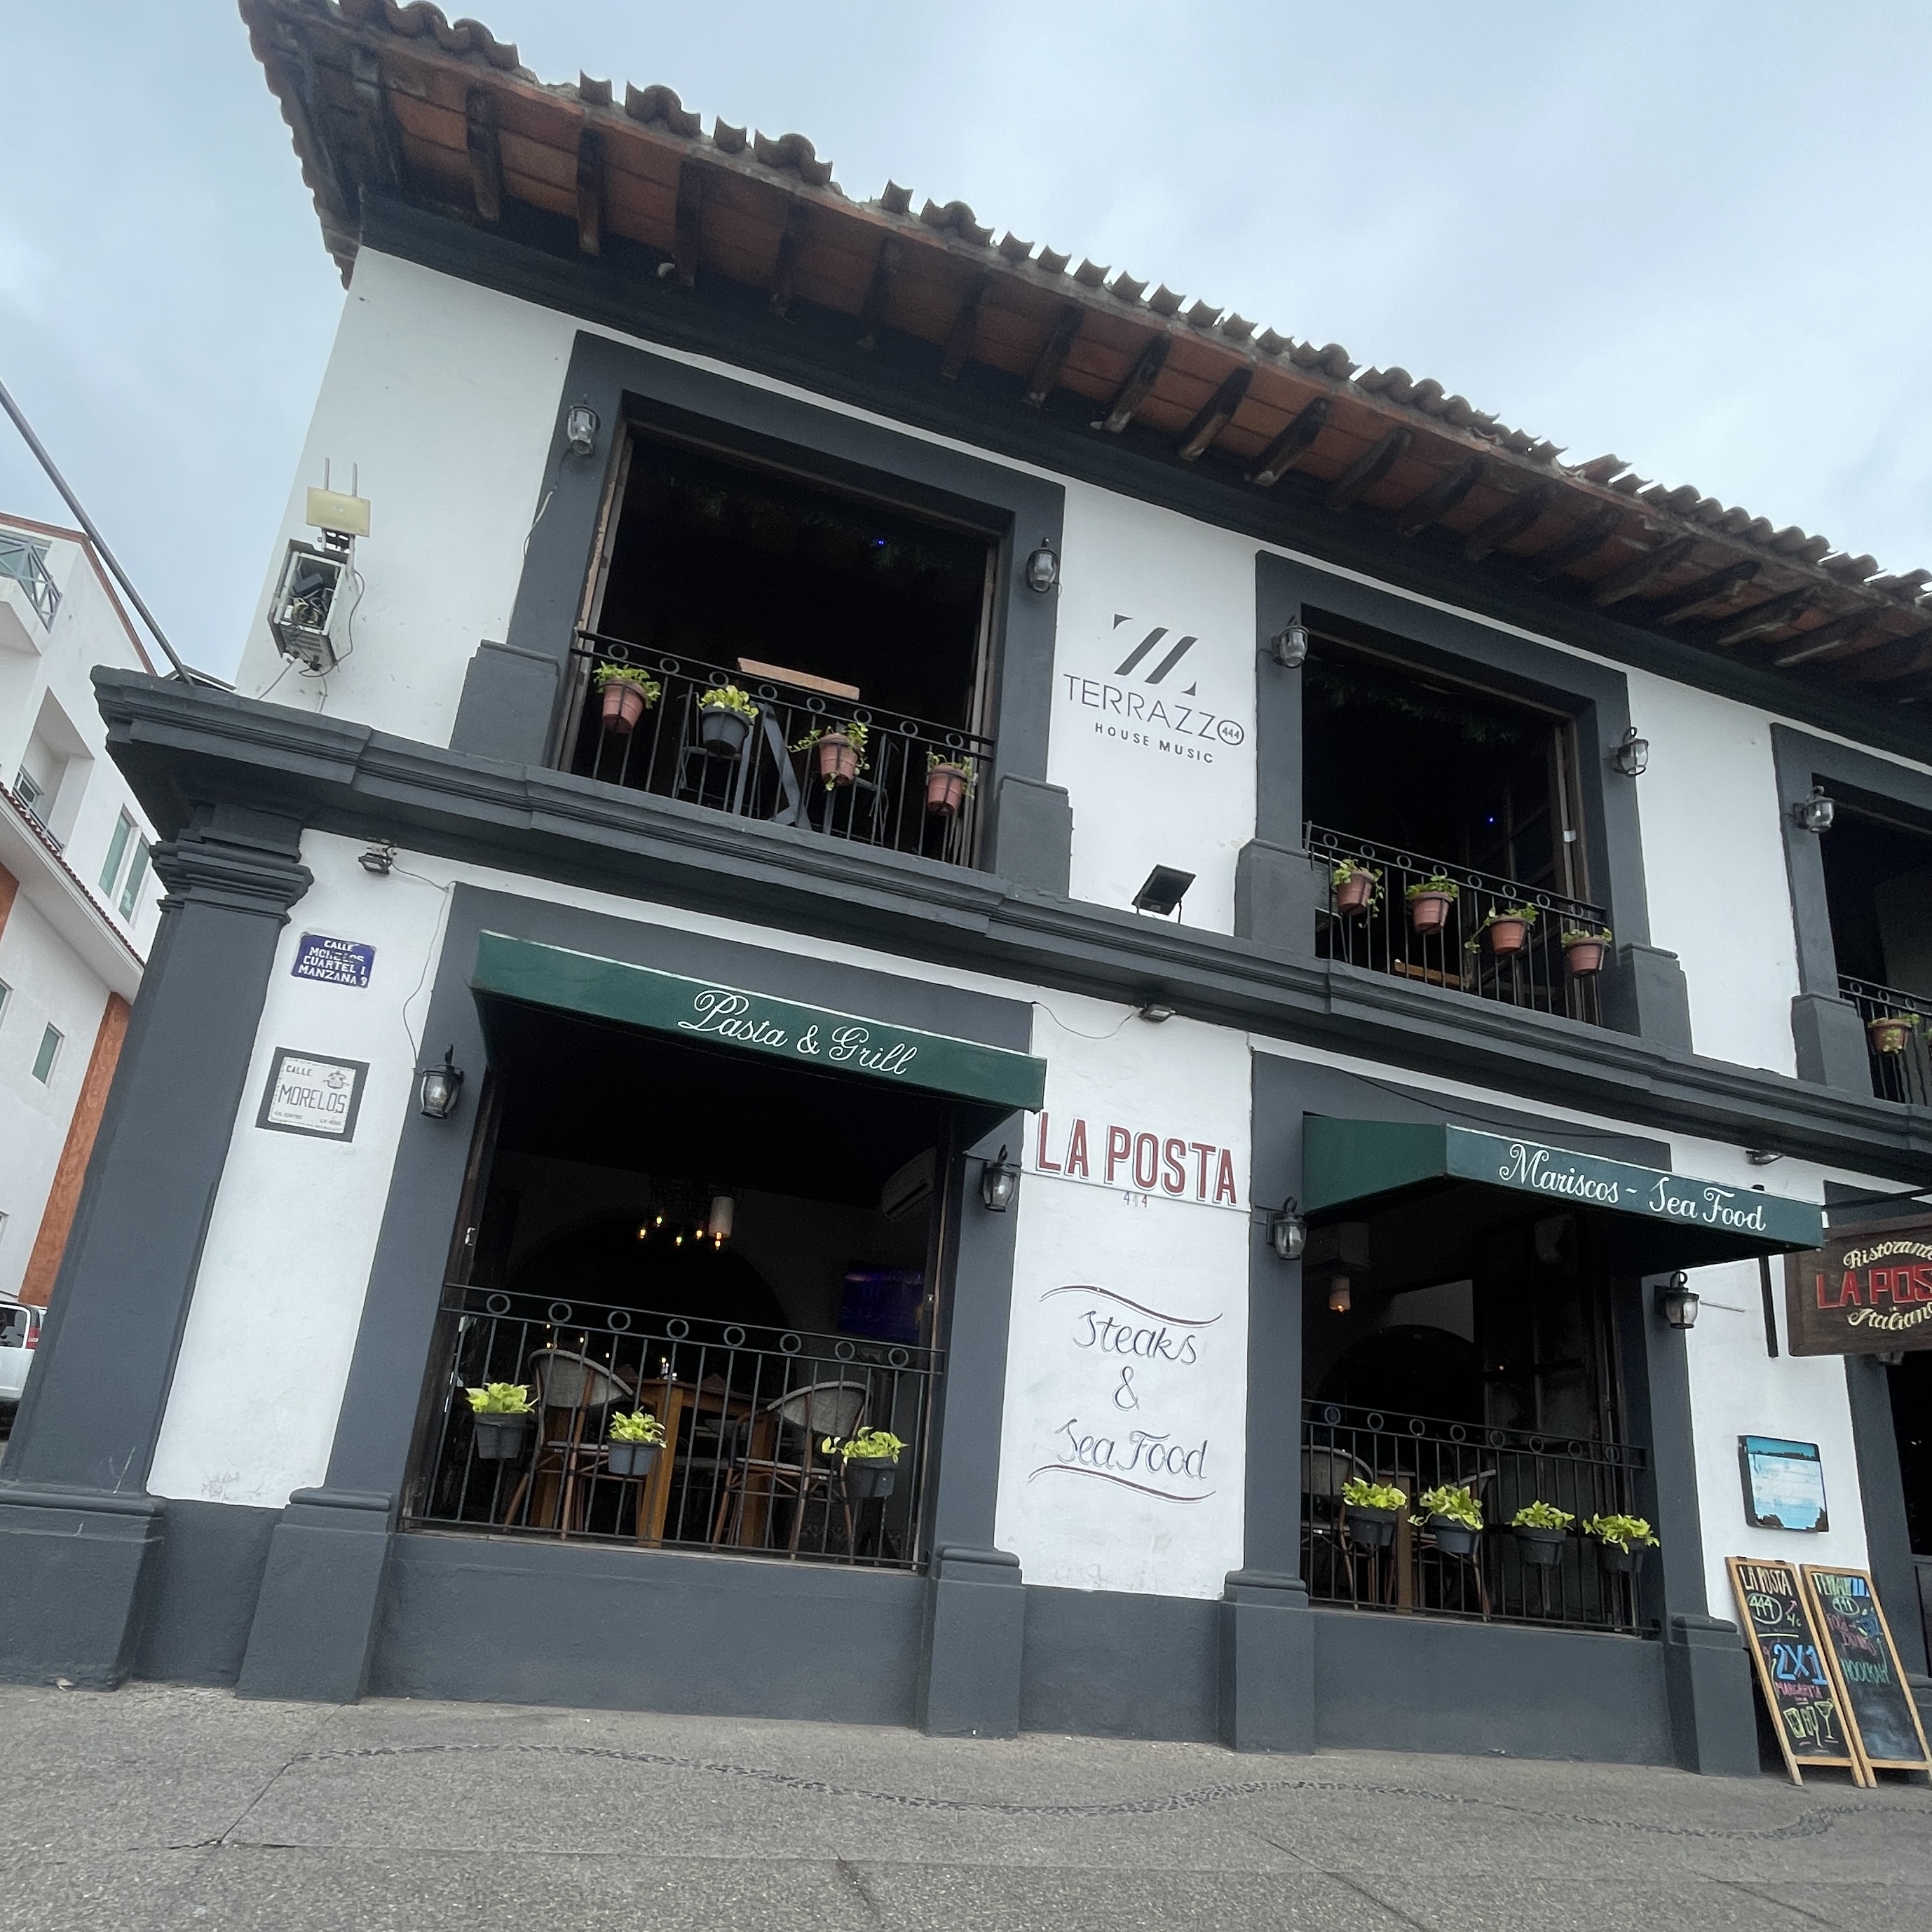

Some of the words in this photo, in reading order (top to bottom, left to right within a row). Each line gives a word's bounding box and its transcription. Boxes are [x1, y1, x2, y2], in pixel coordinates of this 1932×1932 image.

[1094, 722, 1150, 747] HOUSE
[1159, 740, 1213, 763] MUSIC
[1221, 726, 1240, 740] 444
[303, 955, 356, 974] CUARTEL
[324, 940, 353, 952] CALLE
[298, 965, 357, 985] MANZANA
[677, 990, 788, 1047] Pasta
[796, 1025, 821, 1055] &
[829, 1026, 918, 1075] Grill
[286, 1065, 313, 1077] CALLE
[278, 1084, 347, 1114] MORELOS
[1035, 1111, 1089, 1179] LA
[1104, 1124, 1237, 1206] POSTA
[1499, 1143, 1619, 1203] Mariscos
[1648, 1177, 1698, 1219] Sea
[1703, 1187, 1767, 1232] Food
[1816, 1270, 1862, 1309] LA
[1073, 1310, 1197, 1365] Steaks
[1113, 1366, 1140, 1411] &
[1054, 1419, 1116, 1470] Sea
[1116, 1430, 1208, 1480] Food
[1739, 1565, 1759, 1591] LA
[1756, 1566, 1793, 1597] POSTA
[1774, 1644, 1828, 1685] 2X1
